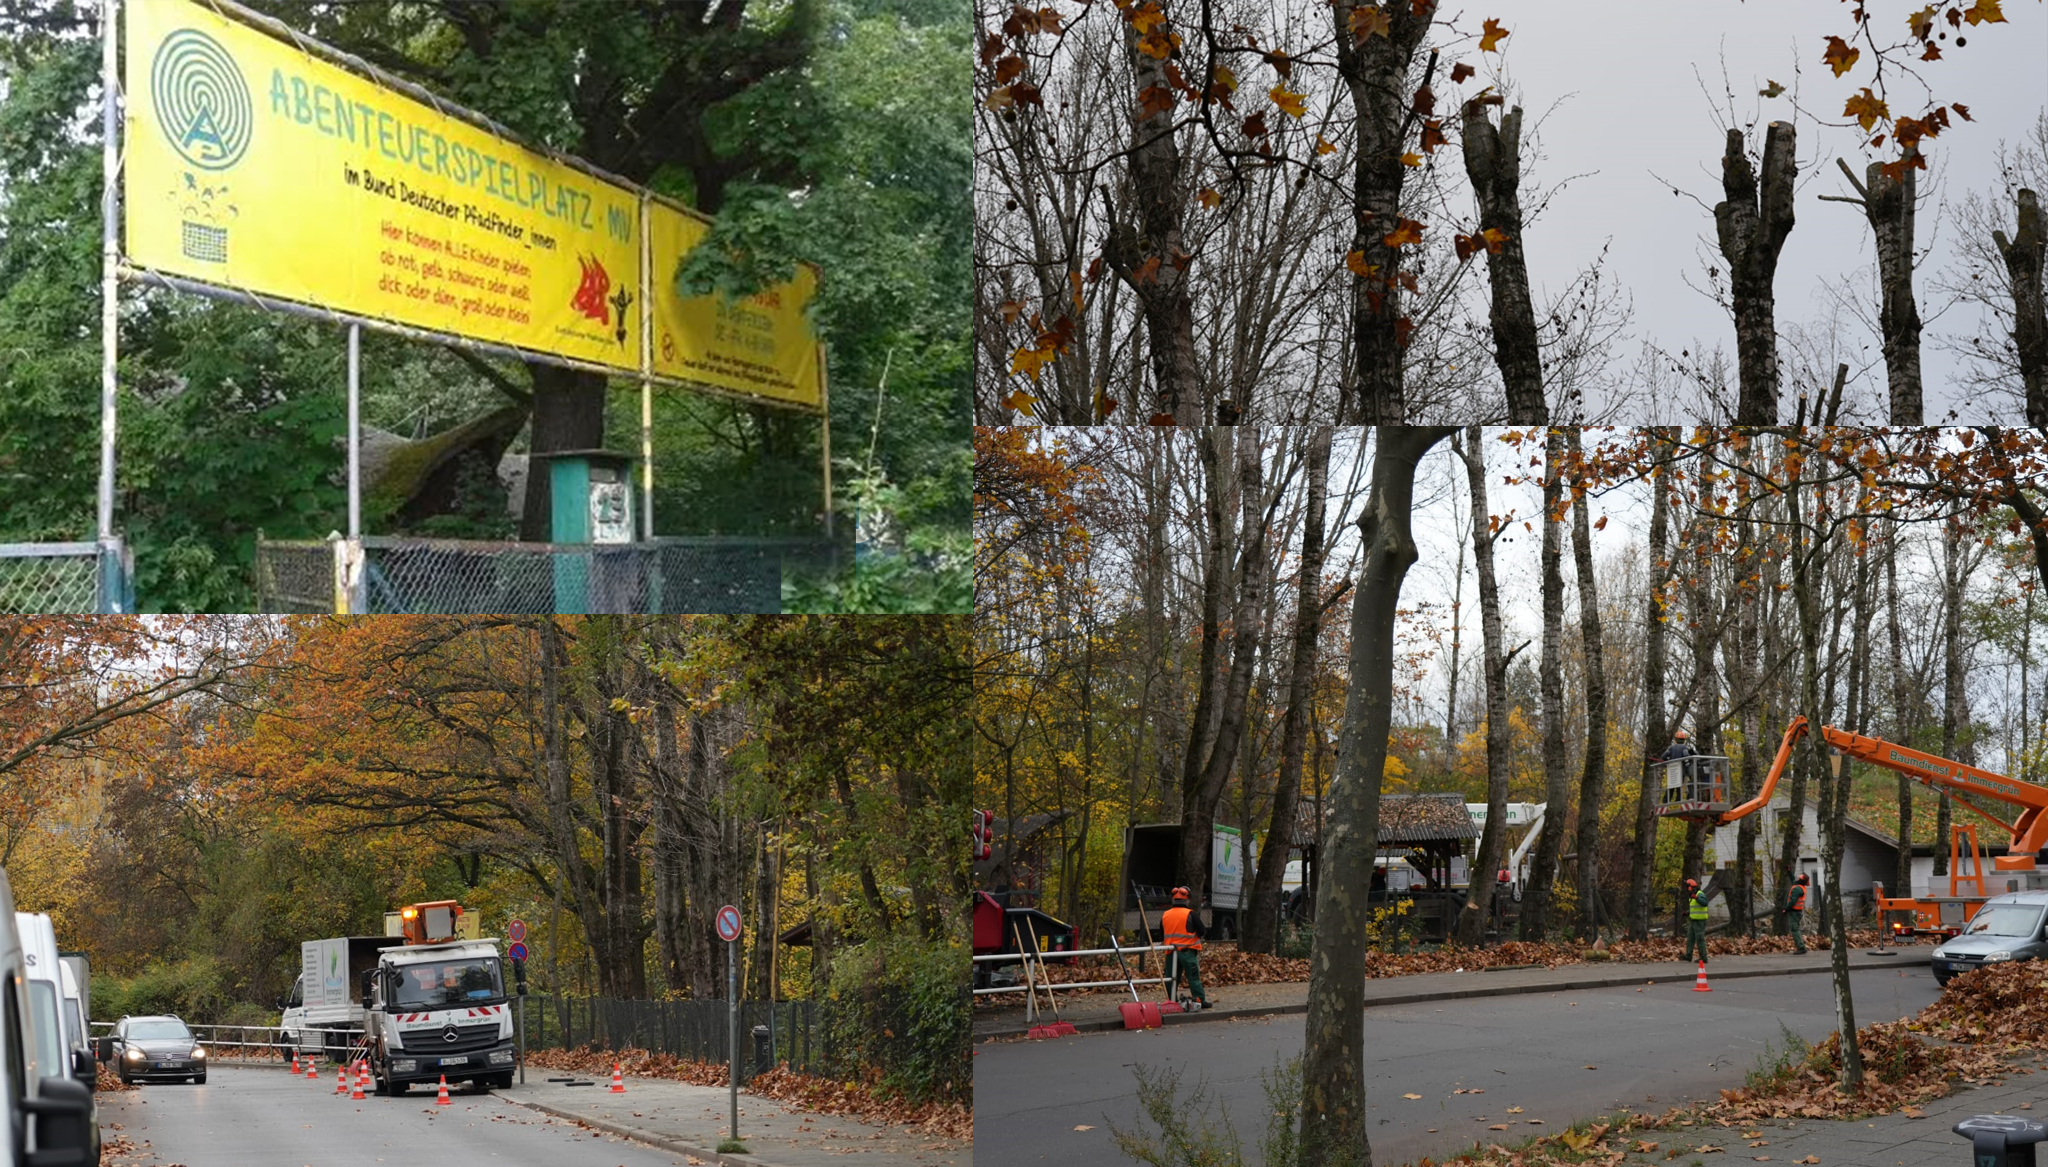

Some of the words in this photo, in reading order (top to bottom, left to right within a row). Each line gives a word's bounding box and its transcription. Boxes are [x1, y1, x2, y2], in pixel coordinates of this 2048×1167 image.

[269, 67, 593, 230] ABENTEUERSPIELPLATZ
[608, 203, 632, 244] MV
[344, 162, 360, 187] im
[364, 169, 396, 200] Bund
[400, 181, 460, 219] Deutscher
[464, 203, 557, 250] Pfadfinder_innen
[445, 240, 468, 261] ALLE
[470, 248, 499, 269] Kinder
[378, 273, 402, 295] dick
[405, 281, 431, 300] oder
[484, 299, 506, 319] oder
[488, 276, 507, 295] oder
[1889, 750, 1950, 776] Baumdienst
[1967, 772, 2020, 797] Immergrün
[406, 1021, 443, 1029] Baumdienst
[457, 1016, 491, 1026] Immergrün
